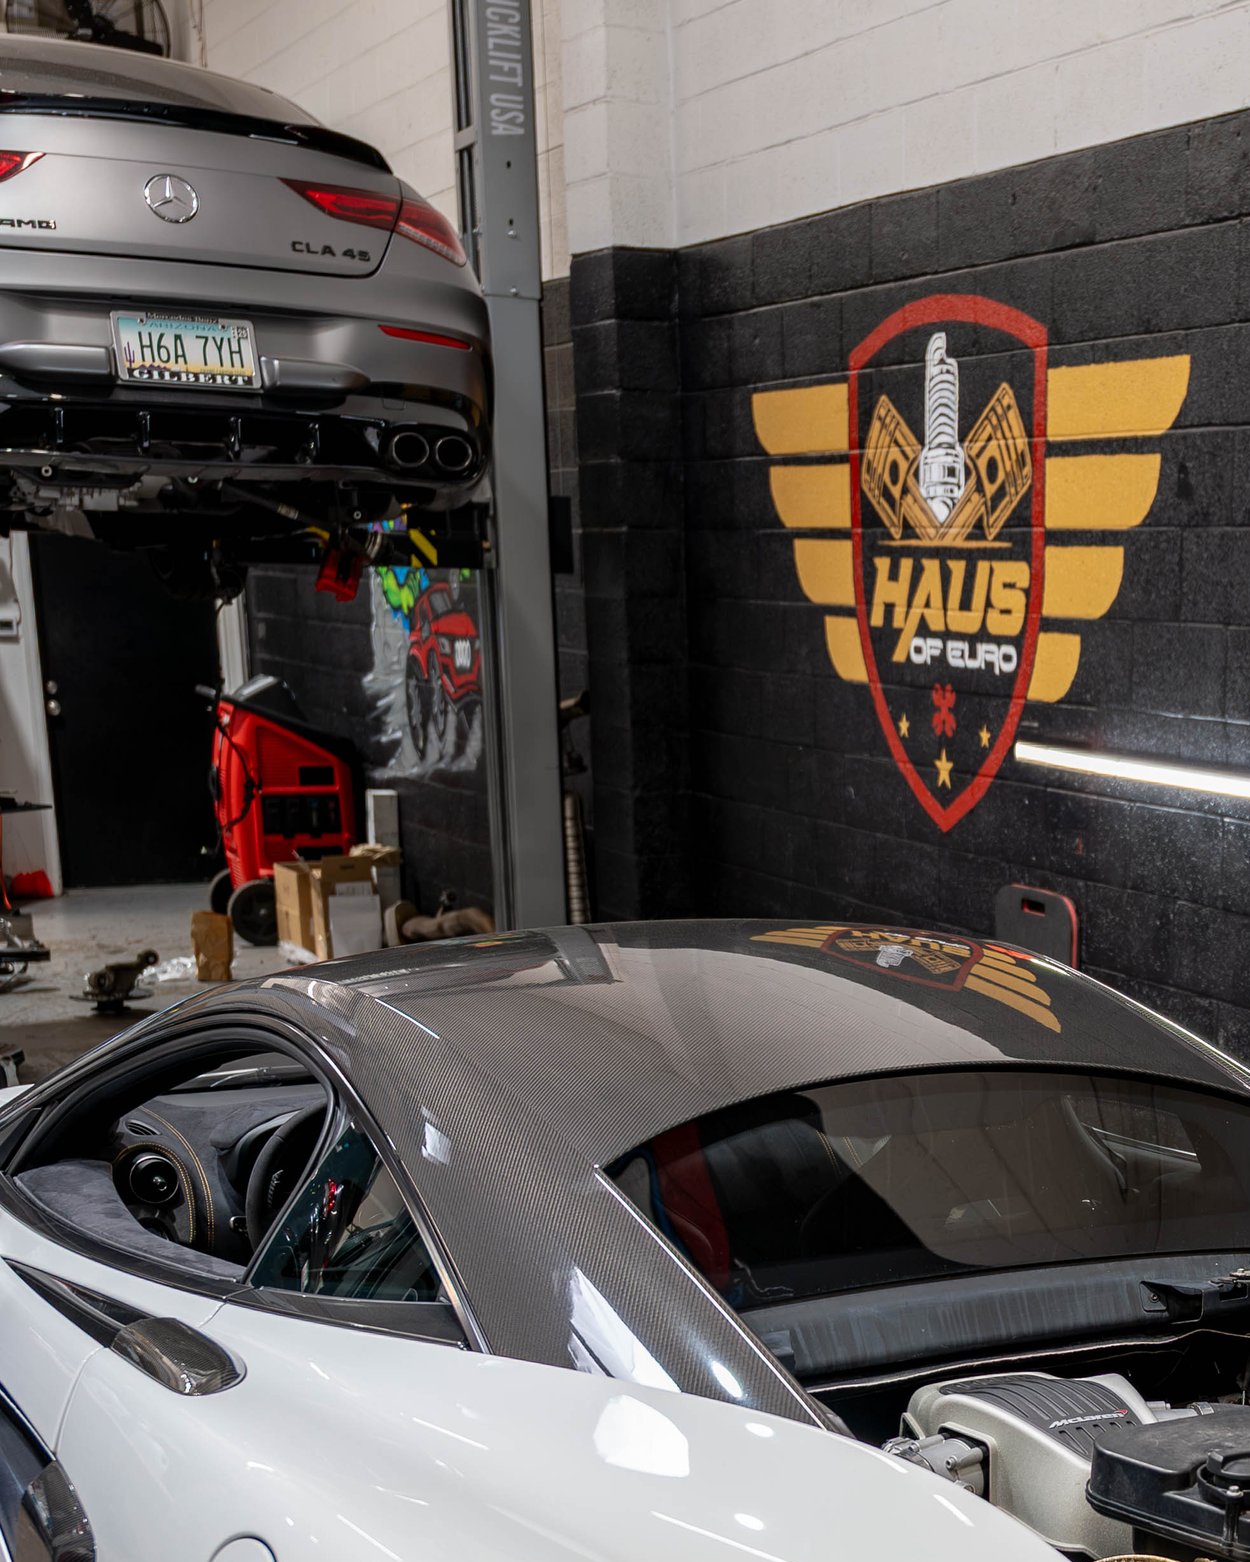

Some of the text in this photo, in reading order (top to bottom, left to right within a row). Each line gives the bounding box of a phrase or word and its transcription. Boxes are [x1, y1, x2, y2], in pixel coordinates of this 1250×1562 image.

[489, 93, 525, 136] USA
[291, 240, 371, 262] CLA 45
[150, 322, 217, 332] ARIZONA
[138, 331, 245, 368] H6A 7YH
[133, 368, 249, 386] GILBERT
[870, 556, 1031, 663] HAUS
[910, 636, 1018, 676] OF EURO
